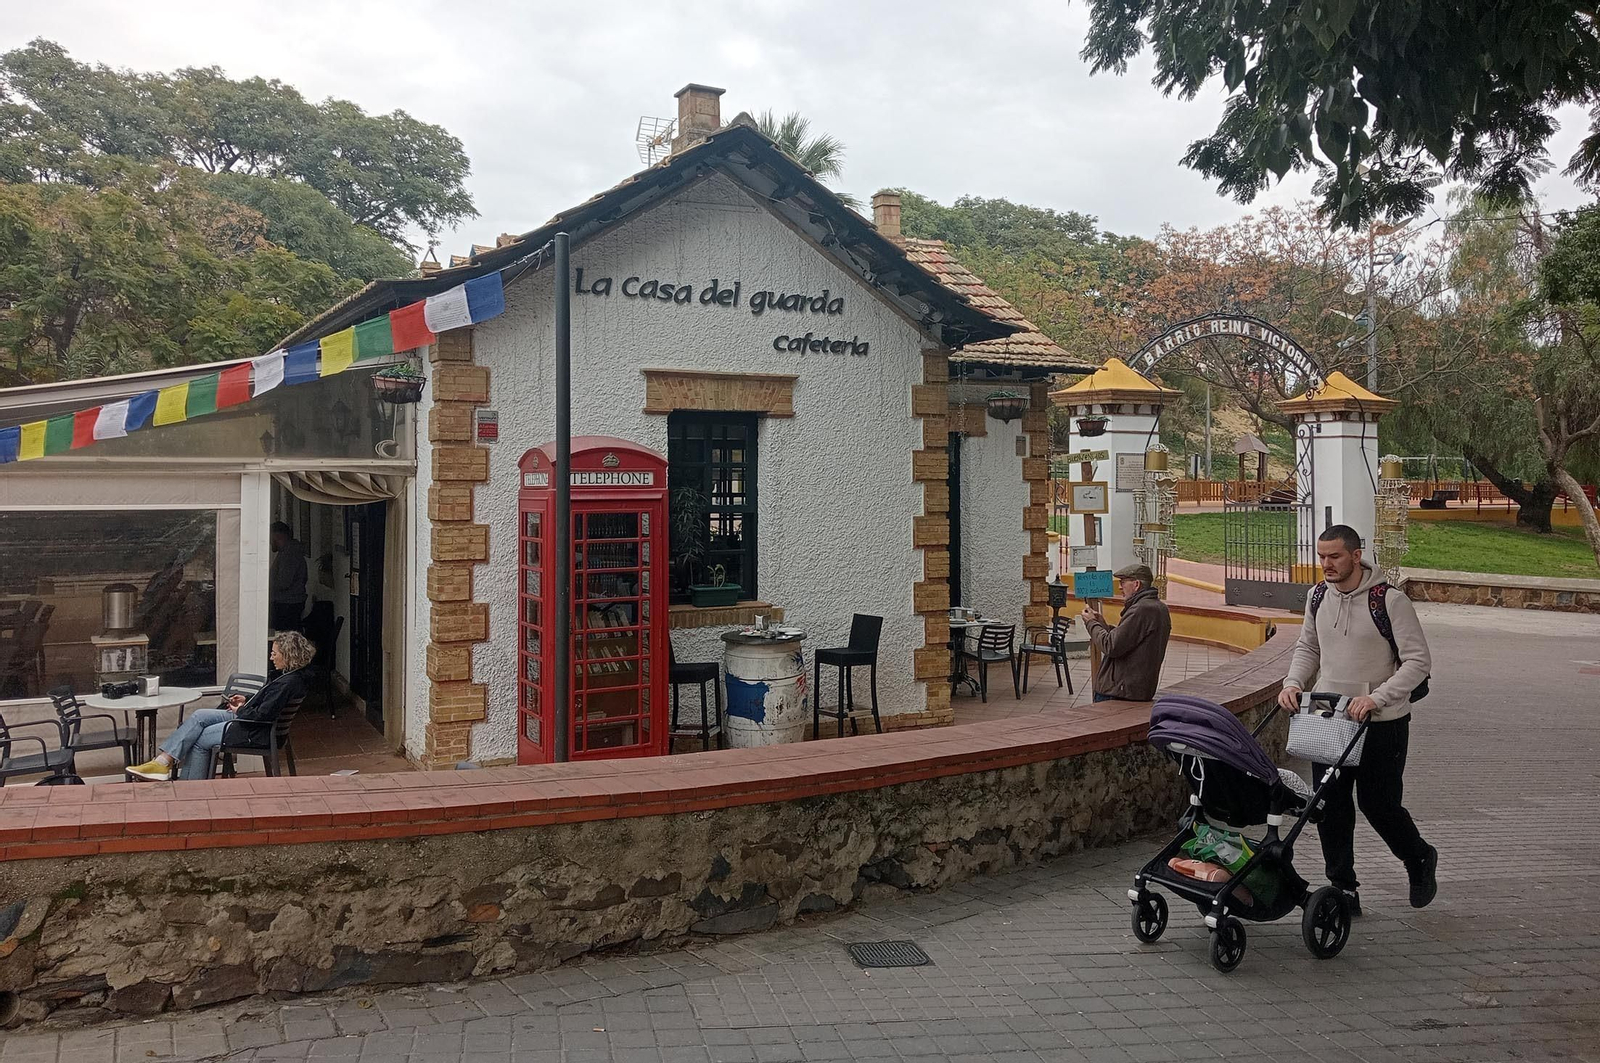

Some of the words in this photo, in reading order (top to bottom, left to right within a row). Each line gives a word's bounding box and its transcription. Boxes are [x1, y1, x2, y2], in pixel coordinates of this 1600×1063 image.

[575, 268, 613, 296] La
[699, 278, 741, 307] del
[749, 289, 844, 315] guarda
[1144, 323, 1200, 366] BARRIO
[1210, 319, 1250, 336] REINA
[1261, 327, 1311, 375] VICTORIA
[572, 472, 650, 485] TELEPHONE
